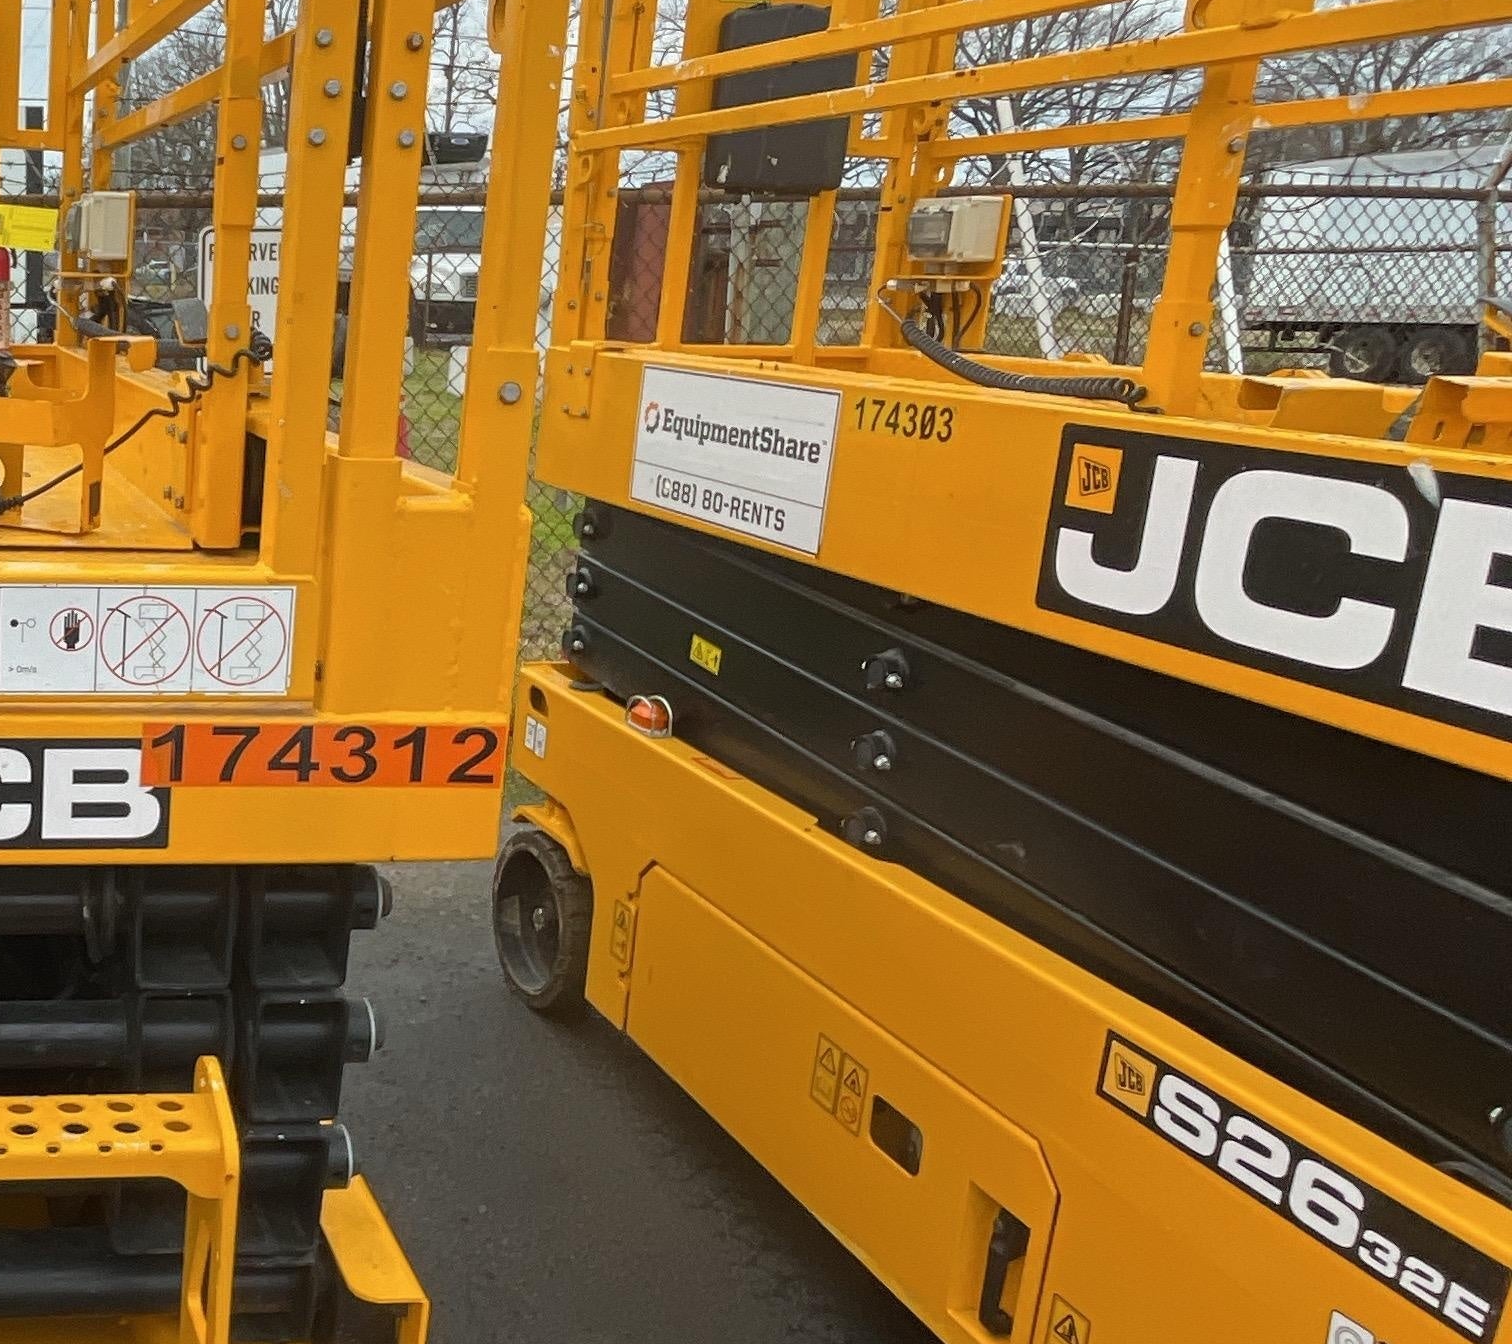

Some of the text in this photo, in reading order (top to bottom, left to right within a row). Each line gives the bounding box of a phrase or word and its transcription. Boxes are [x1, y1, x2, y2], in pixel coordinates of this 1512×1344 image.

[661, 408, 822, 464] EquipmentShare
[855, 397, 954, 443] 174303
[1081, 462, 1111, 492] JCB
[701, 488, 786, 532] 80-RENTS
[150, 724, 499, 785] 174312
[1117, 1058, 1145, 1093] JCB
